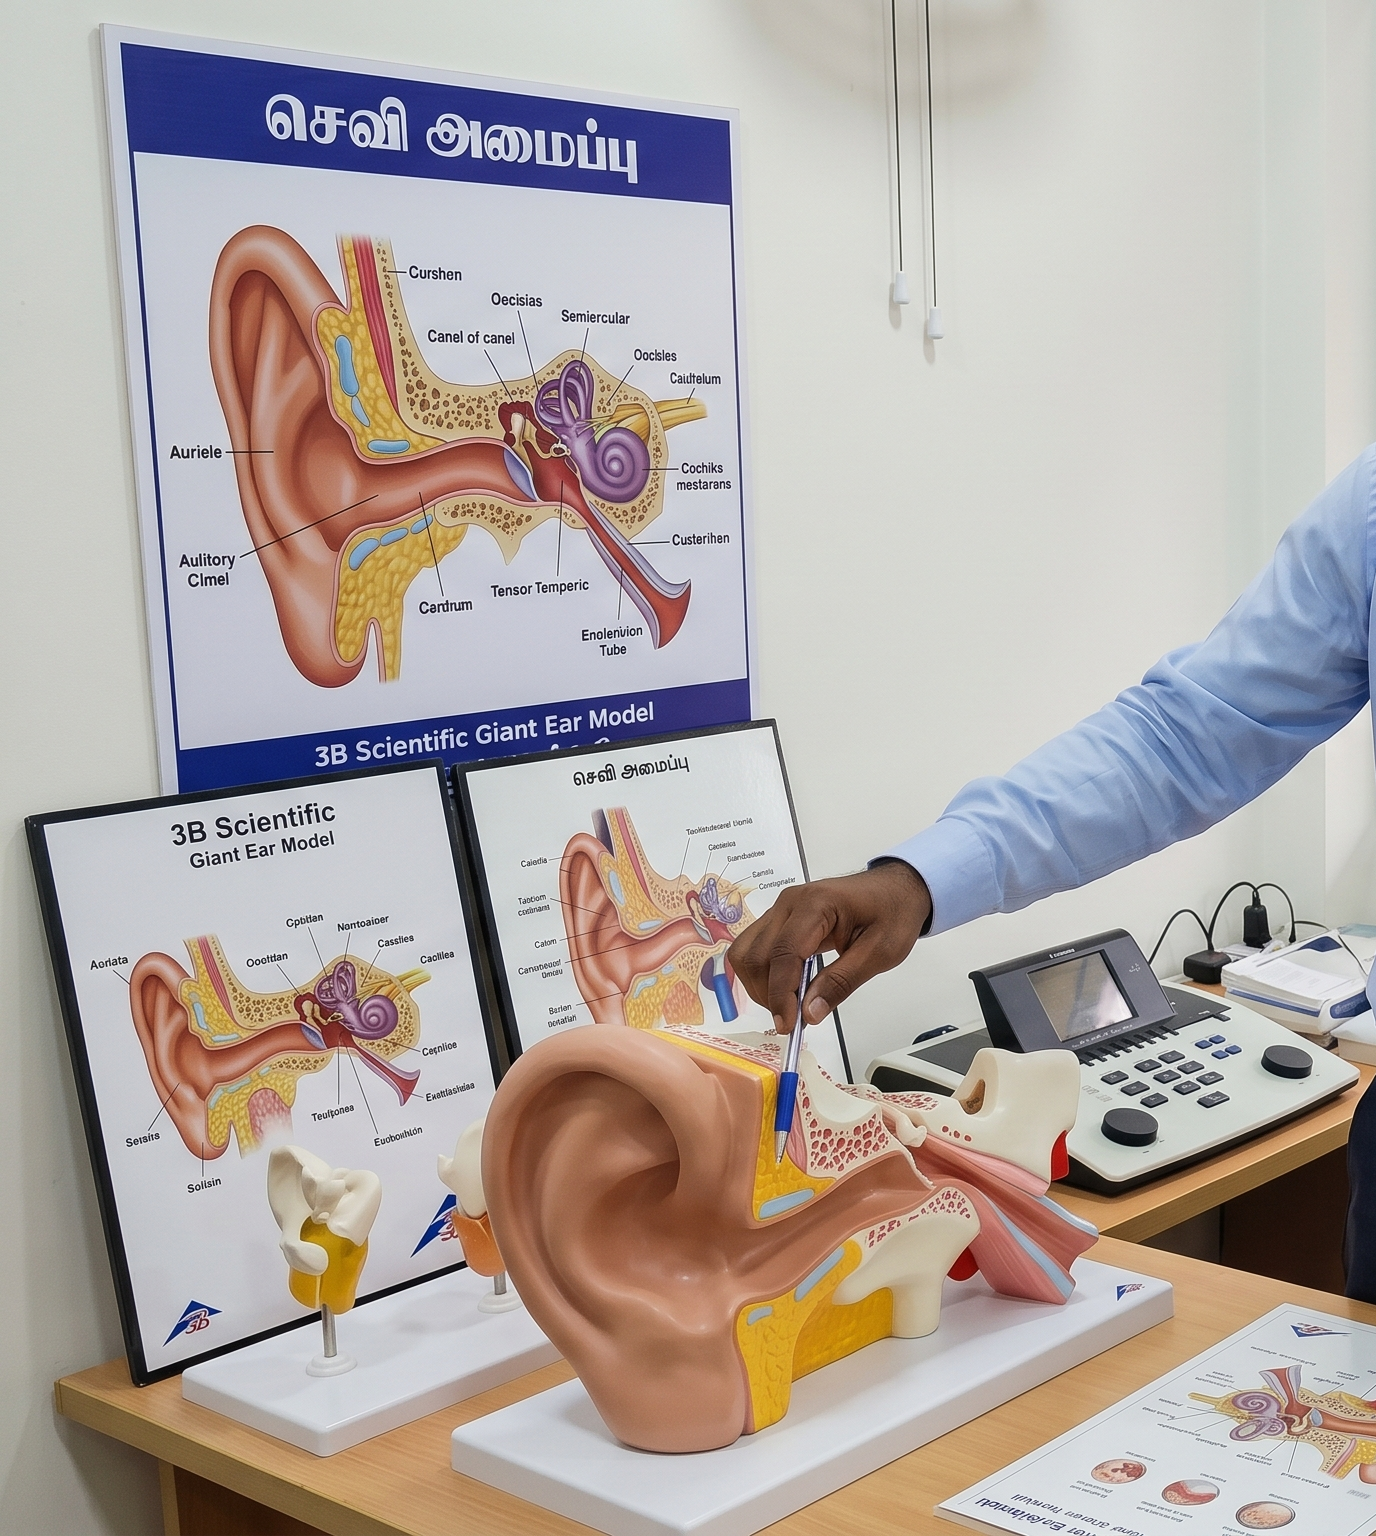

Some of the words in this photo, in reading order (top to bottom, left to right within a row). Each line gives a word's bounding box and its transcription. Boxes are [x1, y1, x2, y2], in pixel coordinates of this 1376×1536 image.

[265, 93, 409, 152] செவி
[426, 113, 638, 185] அமைப்பு
[408, 265, 462, 281] Curshen
[561, 309, 631, 325] Semiercular
[427, 329, 464, 344] Canel
[467, 330, 480, 344] of
[483, 331, 515, 345] canel
[169, 444, 222, 460] Auriele
[681, 461, 724, 475] Cochiks
[178, 552, 236, 570] Aulitory
[490, 584, 533, 598] Tensor
[534, 578, 590, 596] Temperic
[599, 643, 627, 657] Tube
[315, 743, 348, 767] 3B
[355, 726, 469, 762] Scientific
[475, 719, 538, 745] Giant
[545, 714, 583, 736] Ear
[589, 701, 654, 730] Model
[573, 763, 617, 787] செவி
[620, 753, 690, 780] அமைப்பு
[170, 820, 207, 846] 3B
[215, 802, 336, 840] Scientific
[189, 847, 241, 869] Giant
[244, 843, 276, 860] Ear
[280, 830, 335, 854] Model
